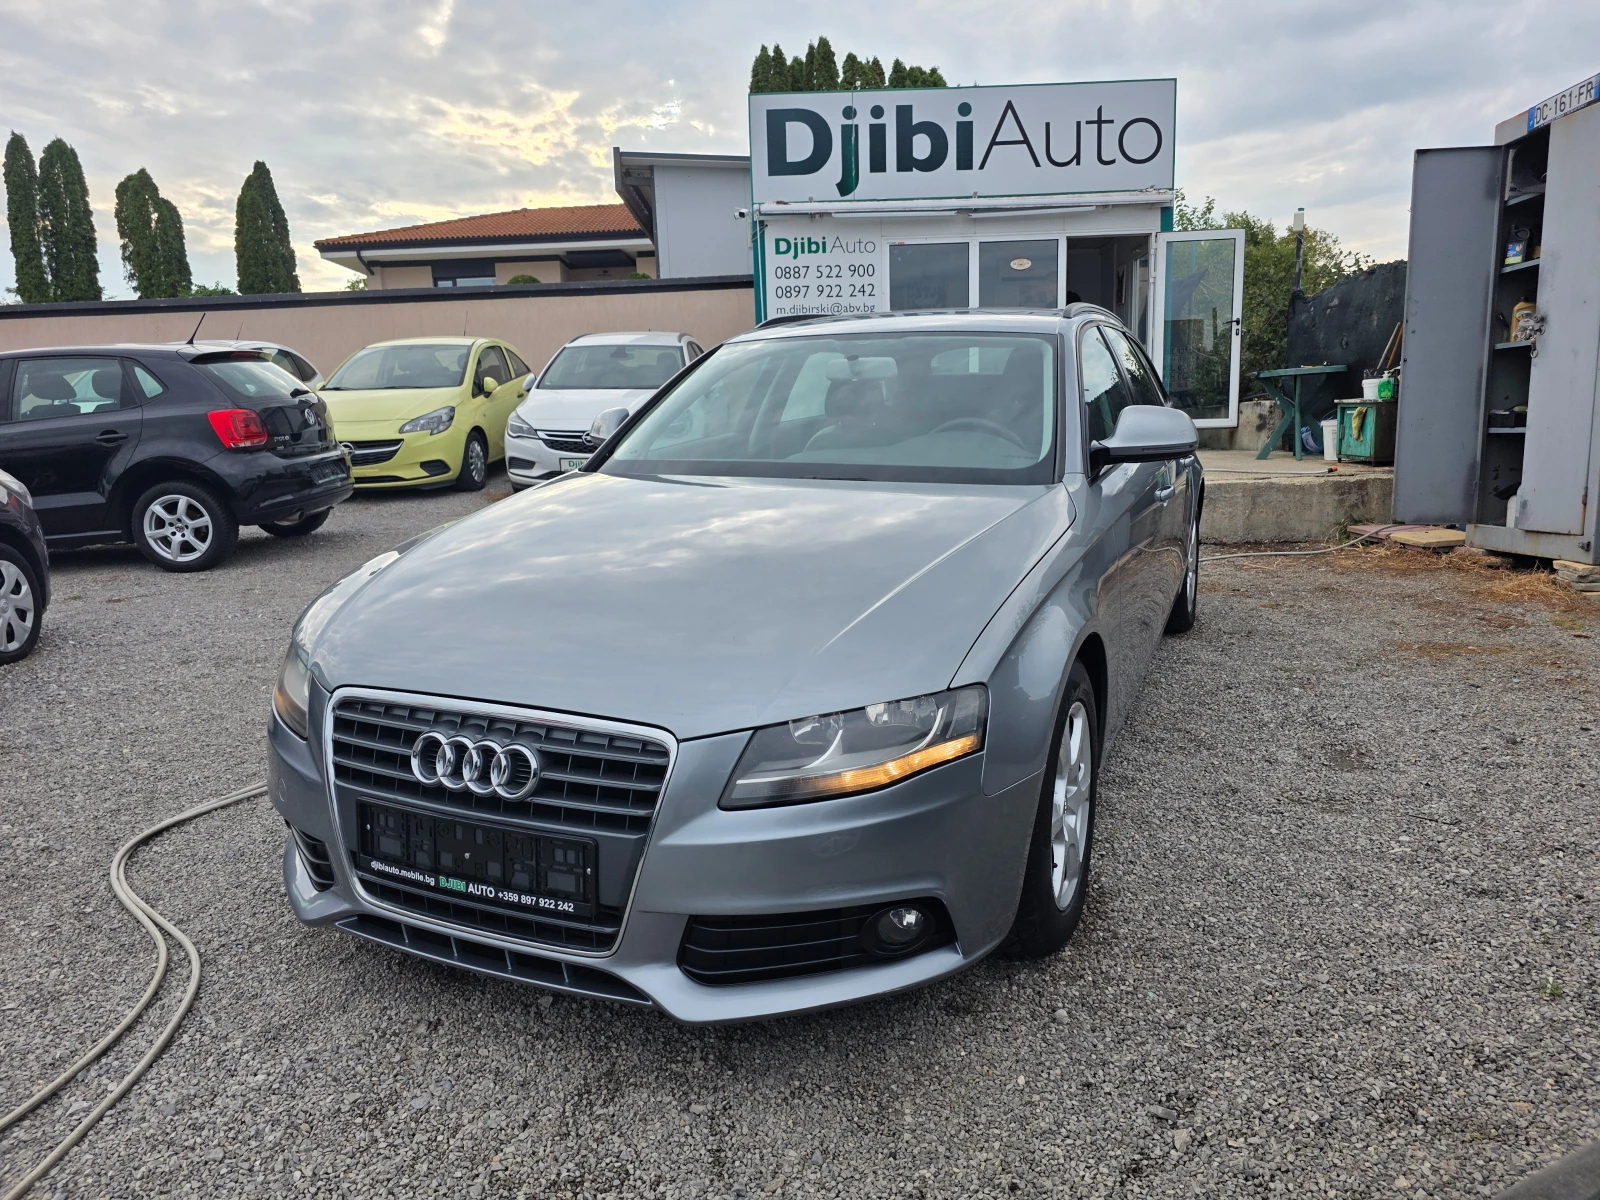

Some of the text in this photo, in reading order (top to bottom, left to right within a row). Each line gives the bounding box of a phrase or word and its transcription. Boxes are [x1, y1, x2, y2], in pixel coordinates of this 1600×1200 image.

[774, 236, 876, 260] Djibi Auto
[775, 263, 876, 280] 0887 522 900
[775, 283, 876, 299] 0897 922 242
[776, 302, 876, 316] m.djibirski@abv.bg
[371, 861, 575, 913] djibiauto.mobile.bg DJIBI AUTO +359 897 922 242
